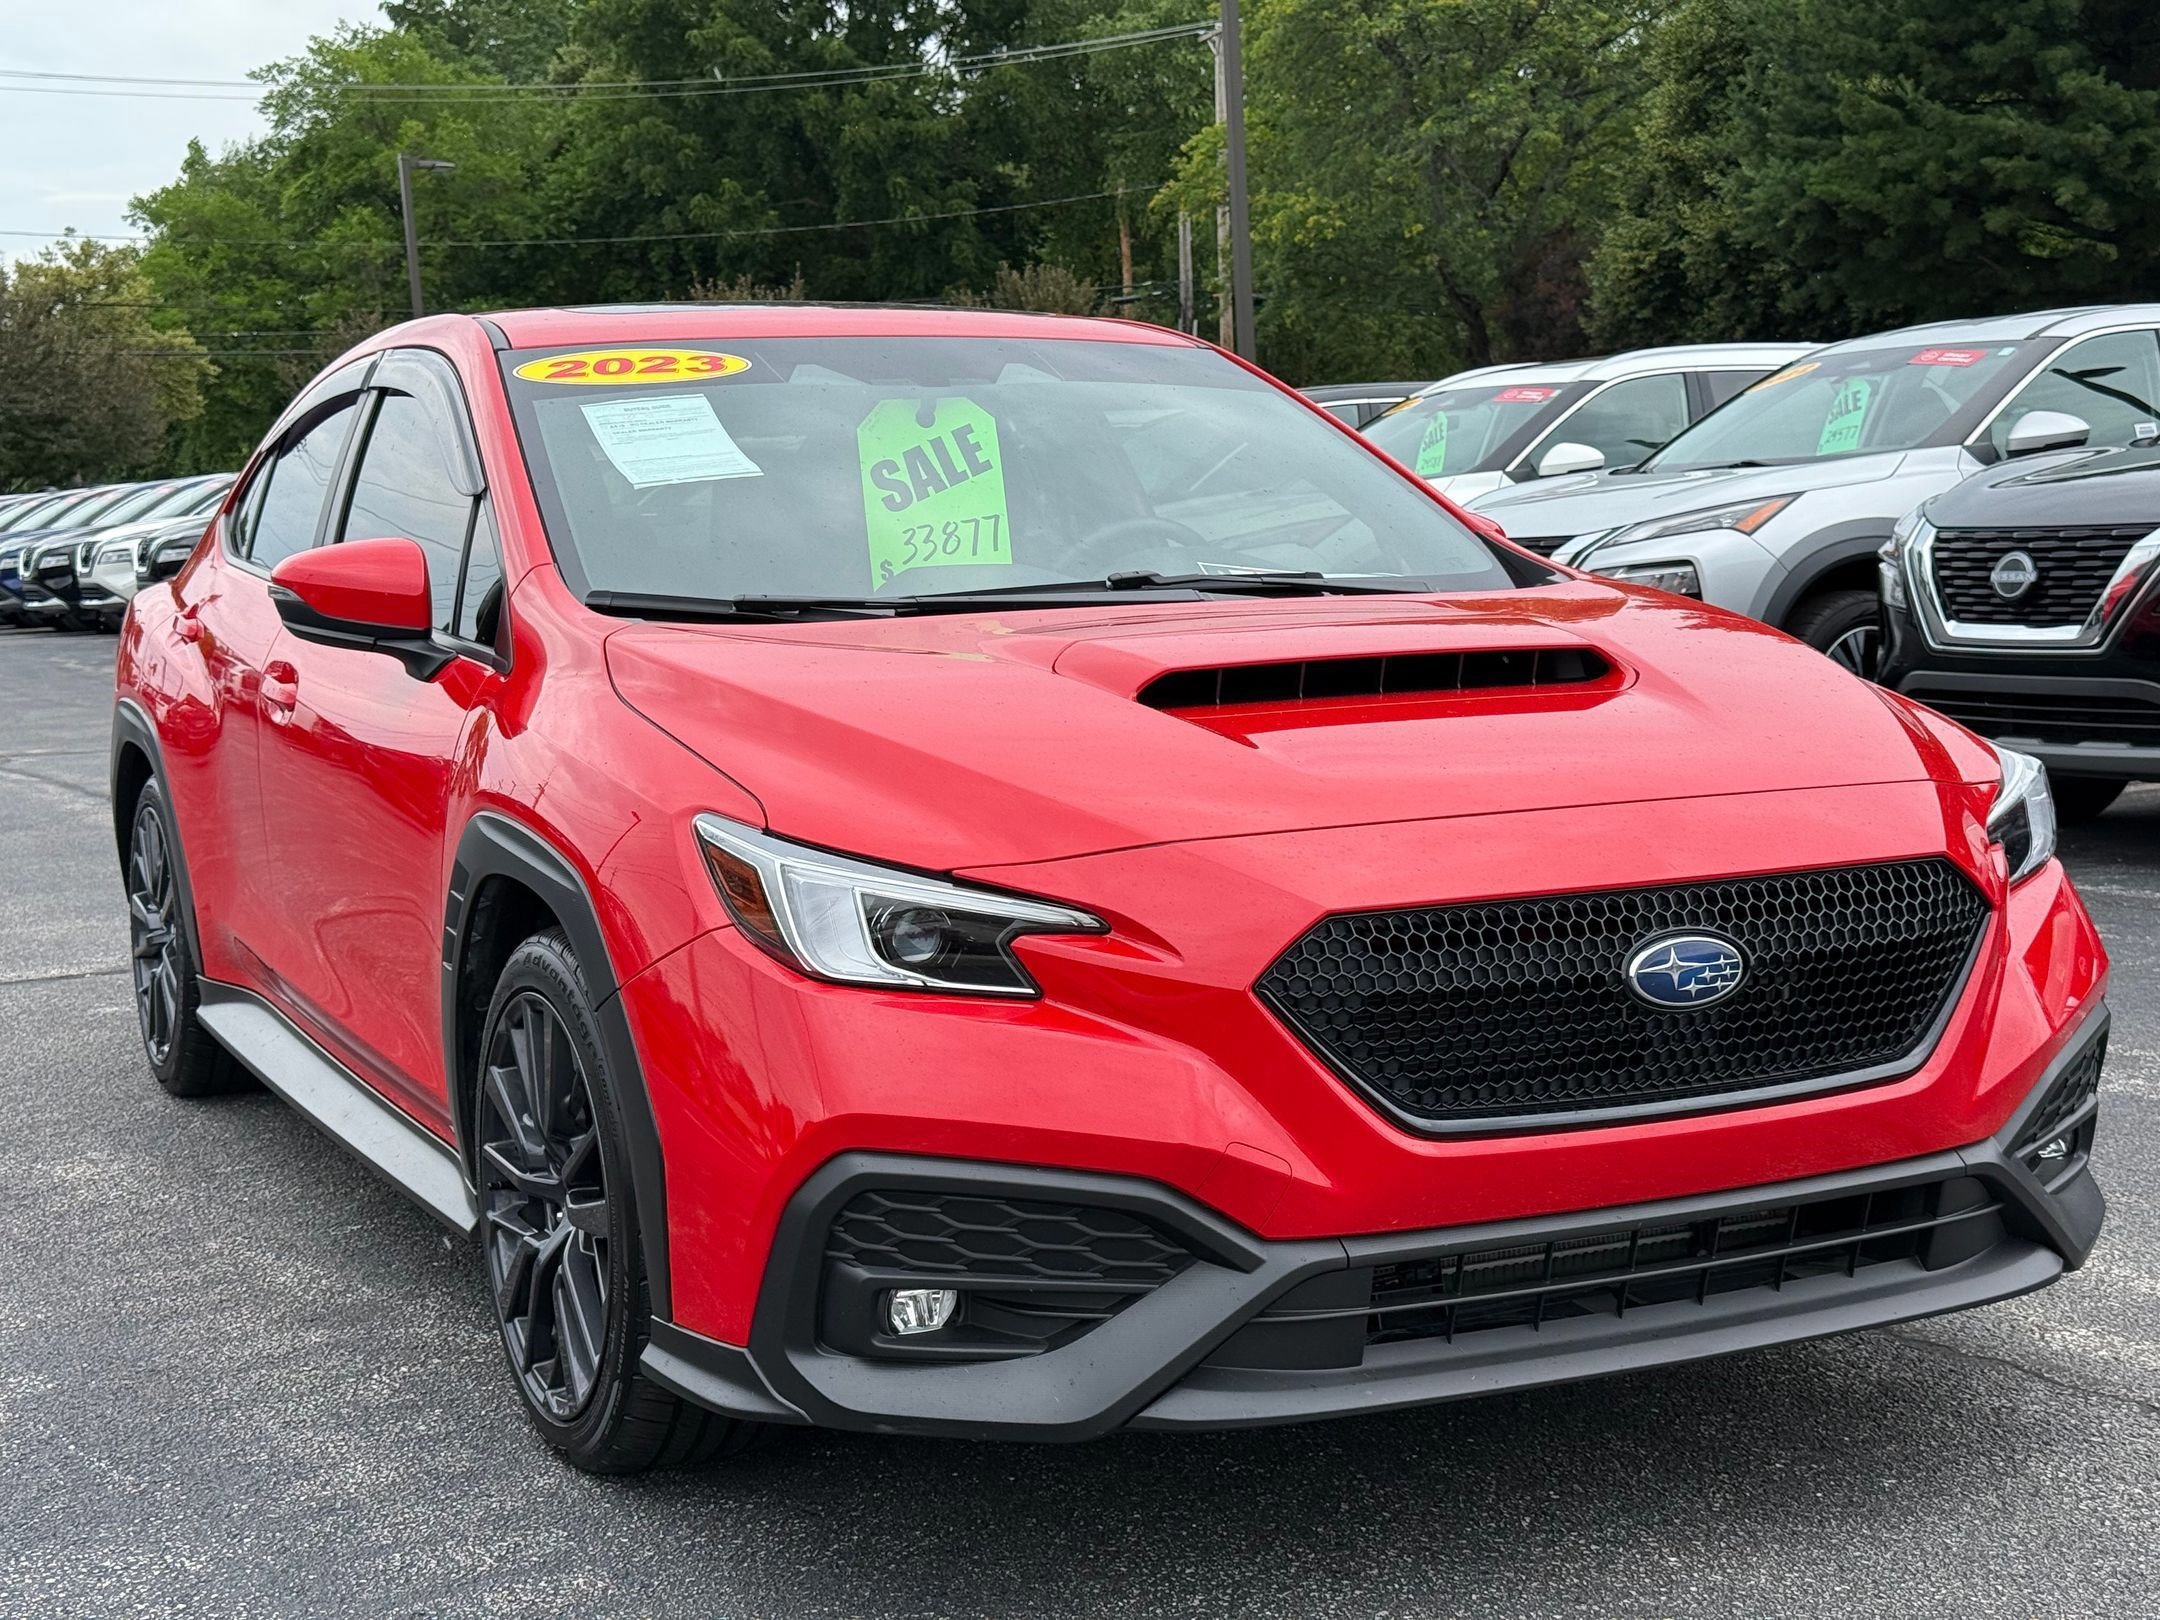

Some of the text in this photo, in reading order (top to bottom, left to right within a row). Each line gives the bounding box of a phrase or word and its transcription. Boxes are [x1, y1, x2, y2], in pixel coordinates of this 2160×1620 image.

[545, 355, 728, 380] 2023
[870, 423, 994, 513] SALE
[901, 513, 1001, 566] 33877
[1990, 569, 2038, 583] NISSAN
